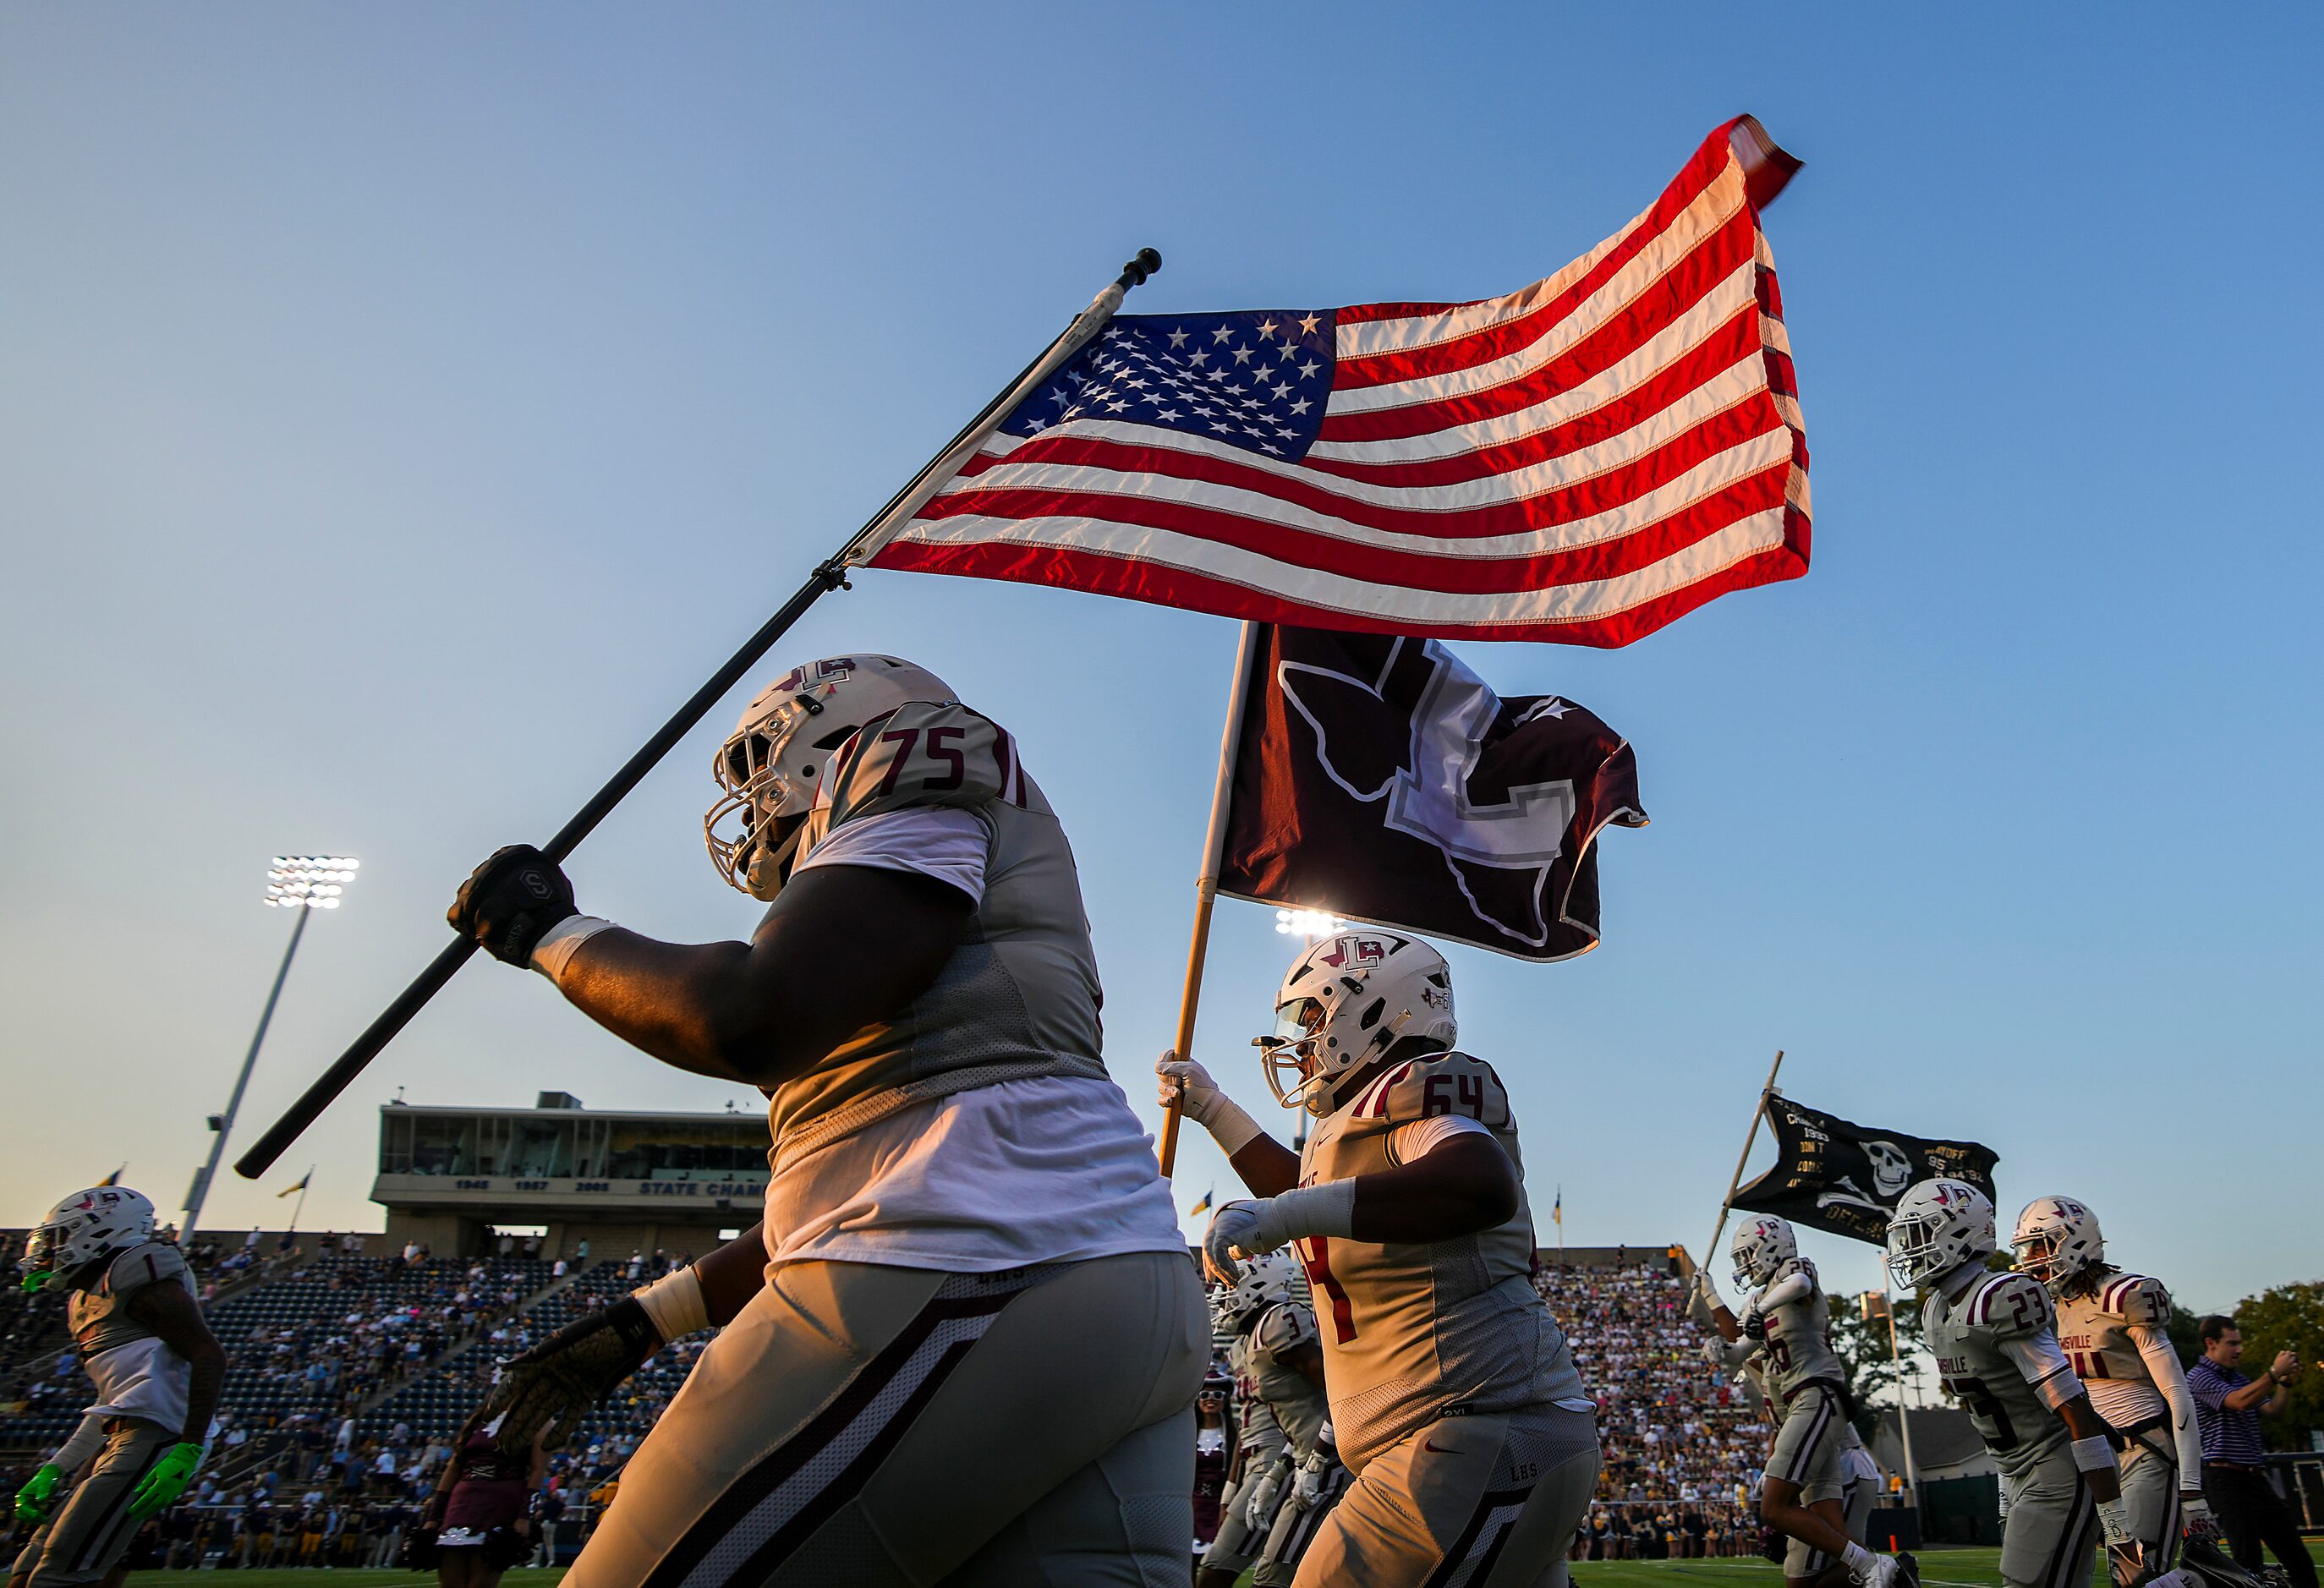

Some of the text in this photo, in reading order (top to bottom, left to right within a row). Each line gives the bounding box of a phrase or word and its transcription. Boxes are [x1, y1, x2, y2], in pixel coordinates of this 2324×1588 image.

[881, 727, 965, 797] 75
[1422, 1074, 1483, 1119] 64
[640, 1182, 697, 1195] STATE
[143, 1253, 157, 1280] 1
[2007, 1286, 2047, 1331] 23
[1282, 1312, 1301, 1340] 3
[1510, 1463, 1537, 1481] LHS
